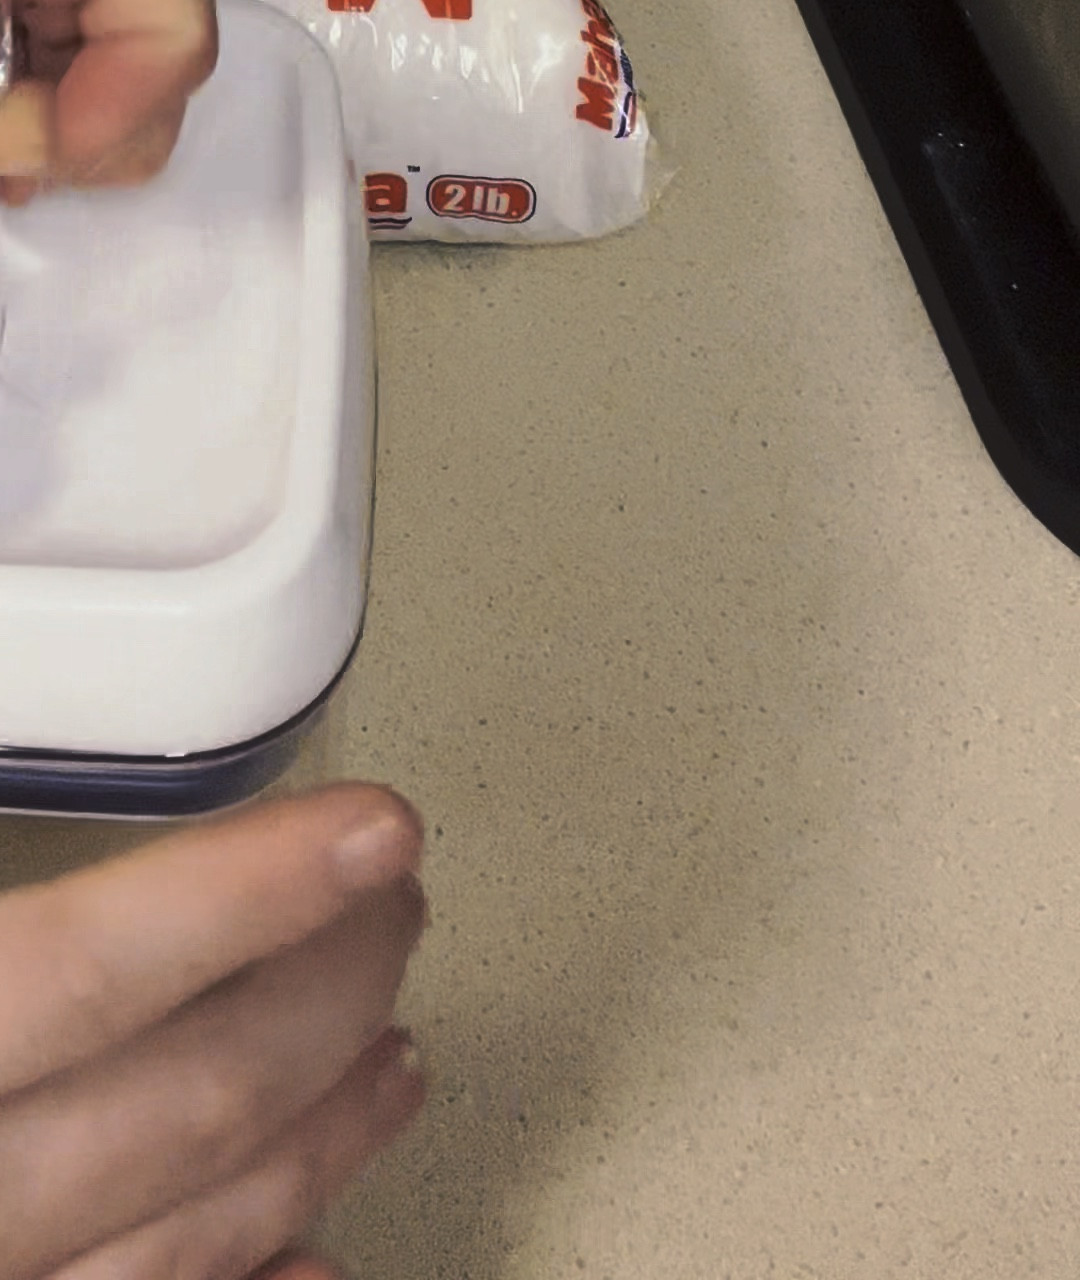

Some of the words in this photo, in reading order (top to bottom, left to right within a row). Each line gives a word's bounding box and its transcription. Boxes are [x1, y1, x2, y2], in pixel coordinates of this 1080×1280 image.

[364, 172, 408, 213] a
[442, 184, 467, 212] 2
[471, 185, 519, 218] lb.
